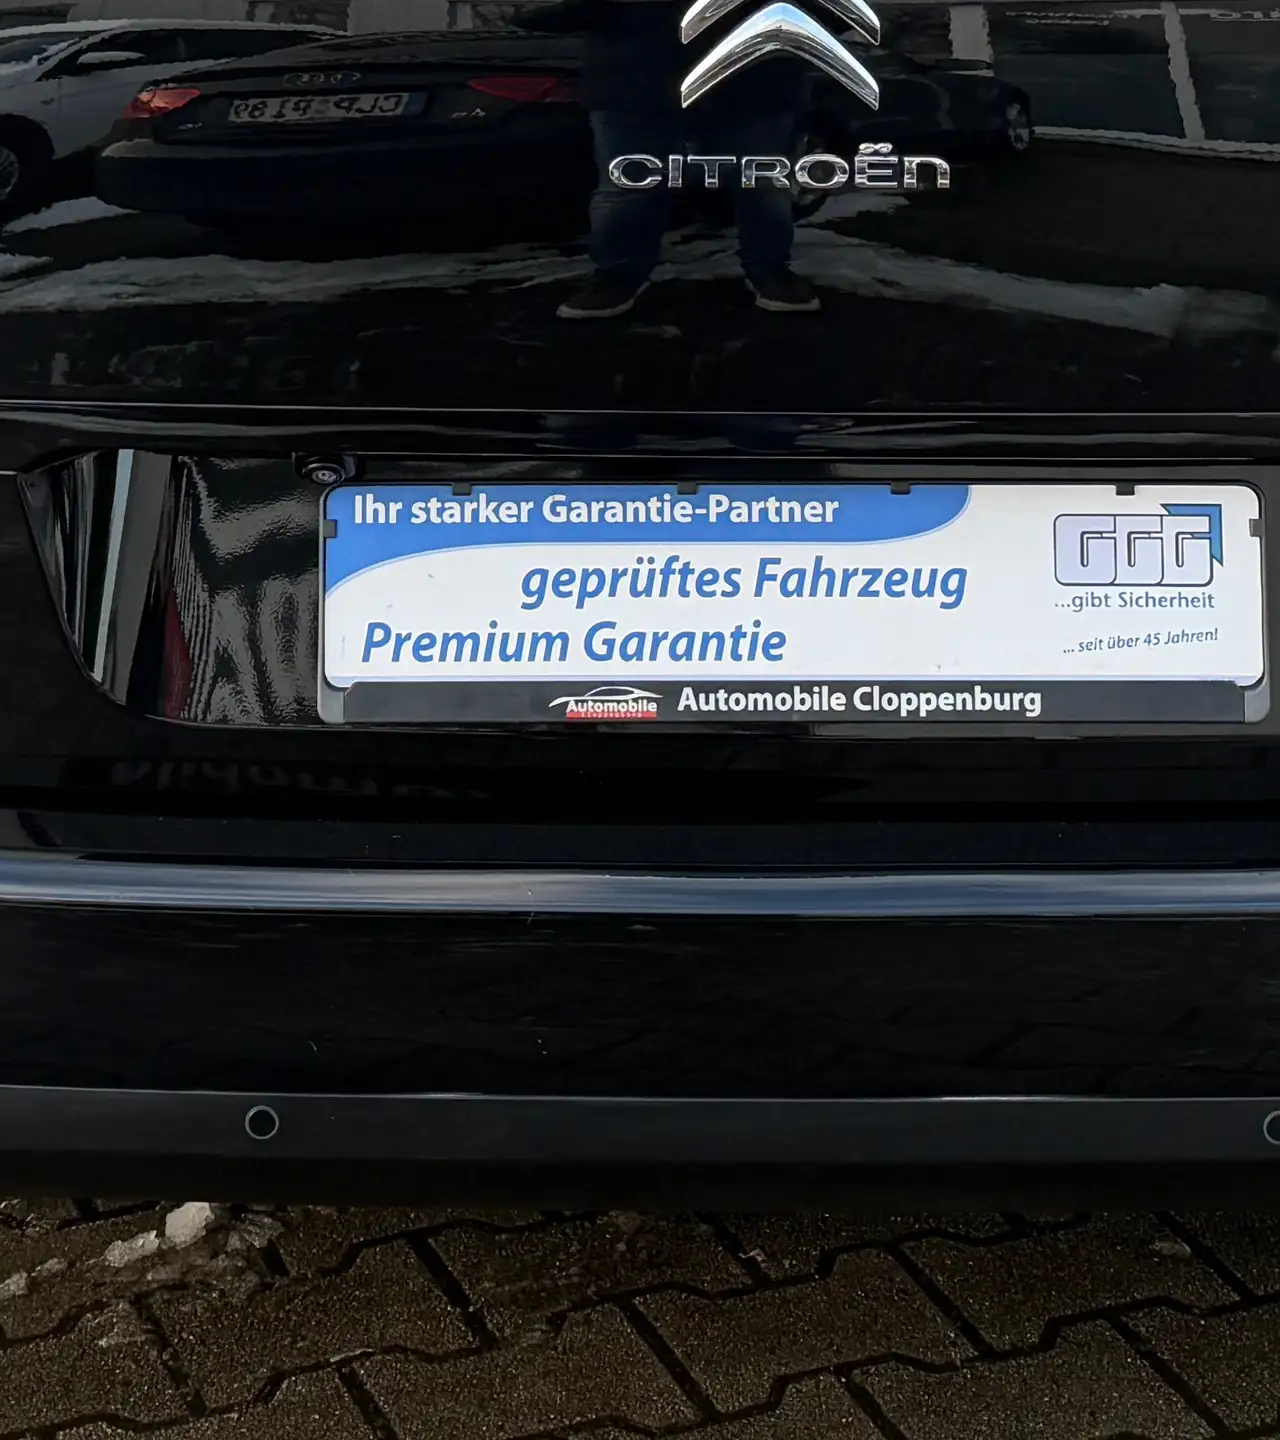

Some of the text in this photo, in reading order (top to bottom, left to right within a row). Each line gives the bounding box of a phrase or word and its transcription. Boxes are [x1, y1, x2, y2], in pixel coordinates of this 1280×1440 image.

[354, 493, 839, 524] Ihr starker Garantie-Partner
[521, 554, 967, 610] geprüftes Fahrzeug
[1118, 592, 1215, 609] Sicherheit
[362, 619, 787, 663] Premium Garantie
[1078, 637, 1104, 653] seit
[1107, 634, 1140, 650] über
[1143, 632, 1161, 647] 45
[1164, 627, 1218, 645] Jahren!
[566, 700, 658, 713] Automobile
[678, 685, 1042, 717] Automobile Cloppenburg
